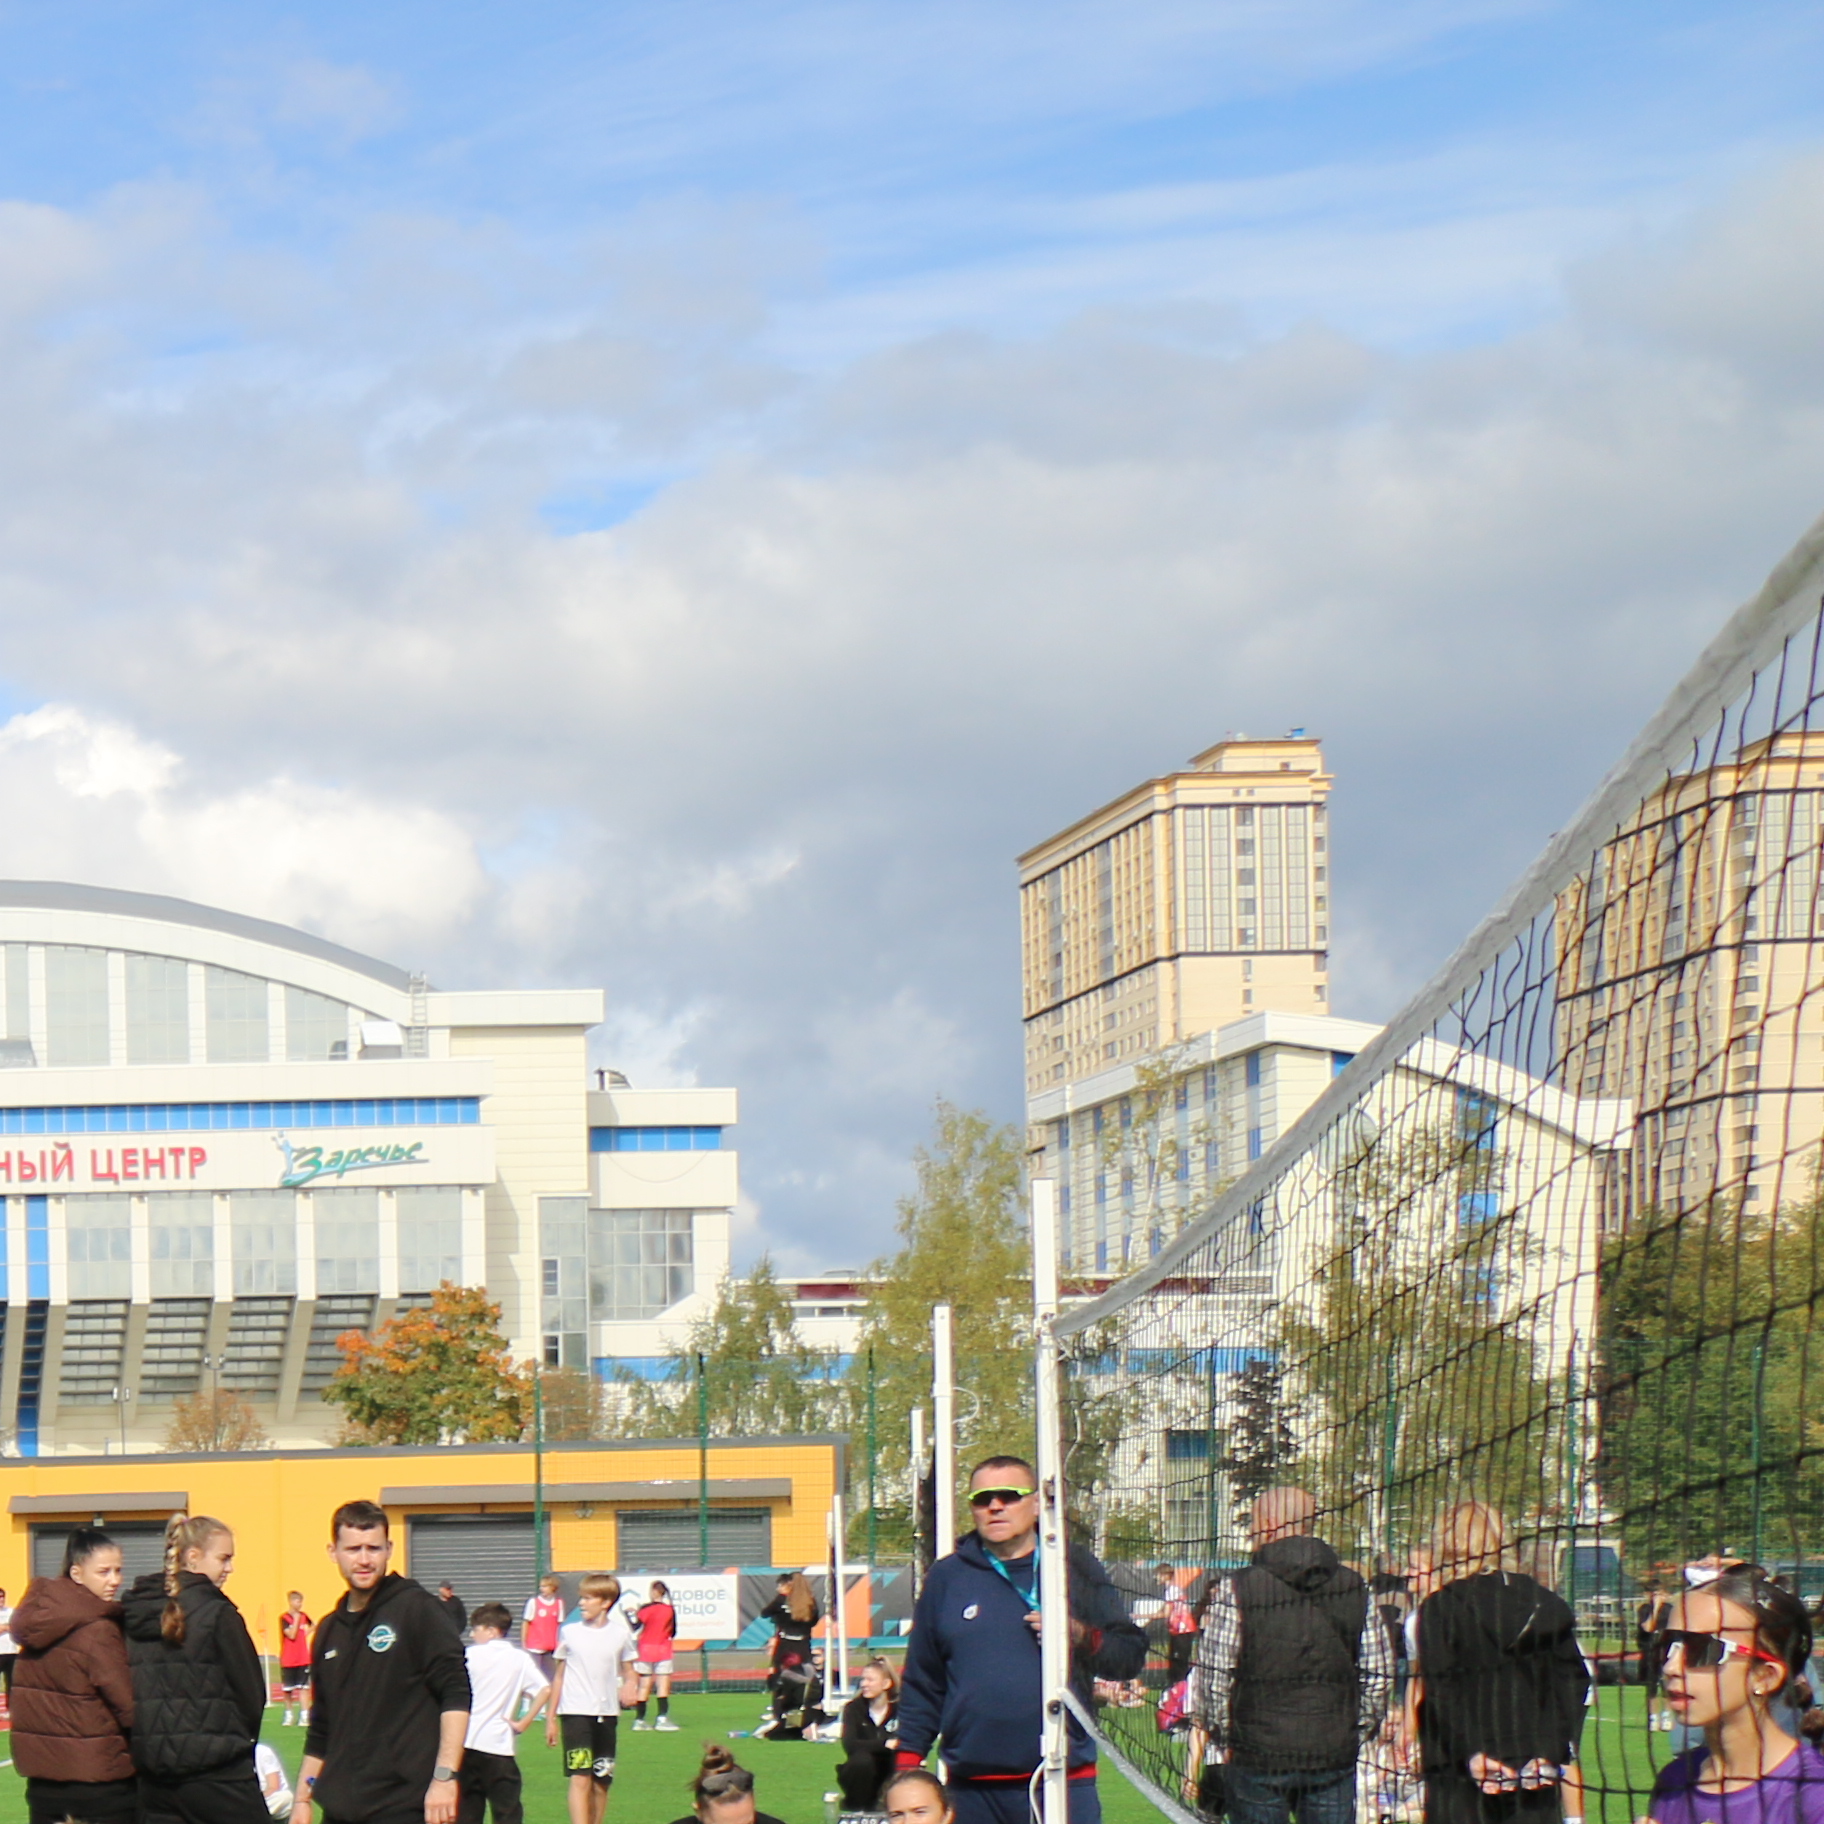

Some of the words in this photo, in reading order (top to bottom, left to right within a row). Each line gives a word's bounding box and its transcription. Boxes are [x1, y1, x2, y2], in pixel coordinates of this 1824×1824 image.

[90, 1146, 208, 1184] ЦЕНТР
[281, 1141, 424, 1187] Заречье
[670, 1589, 726, 1603] ДОВОЕ
